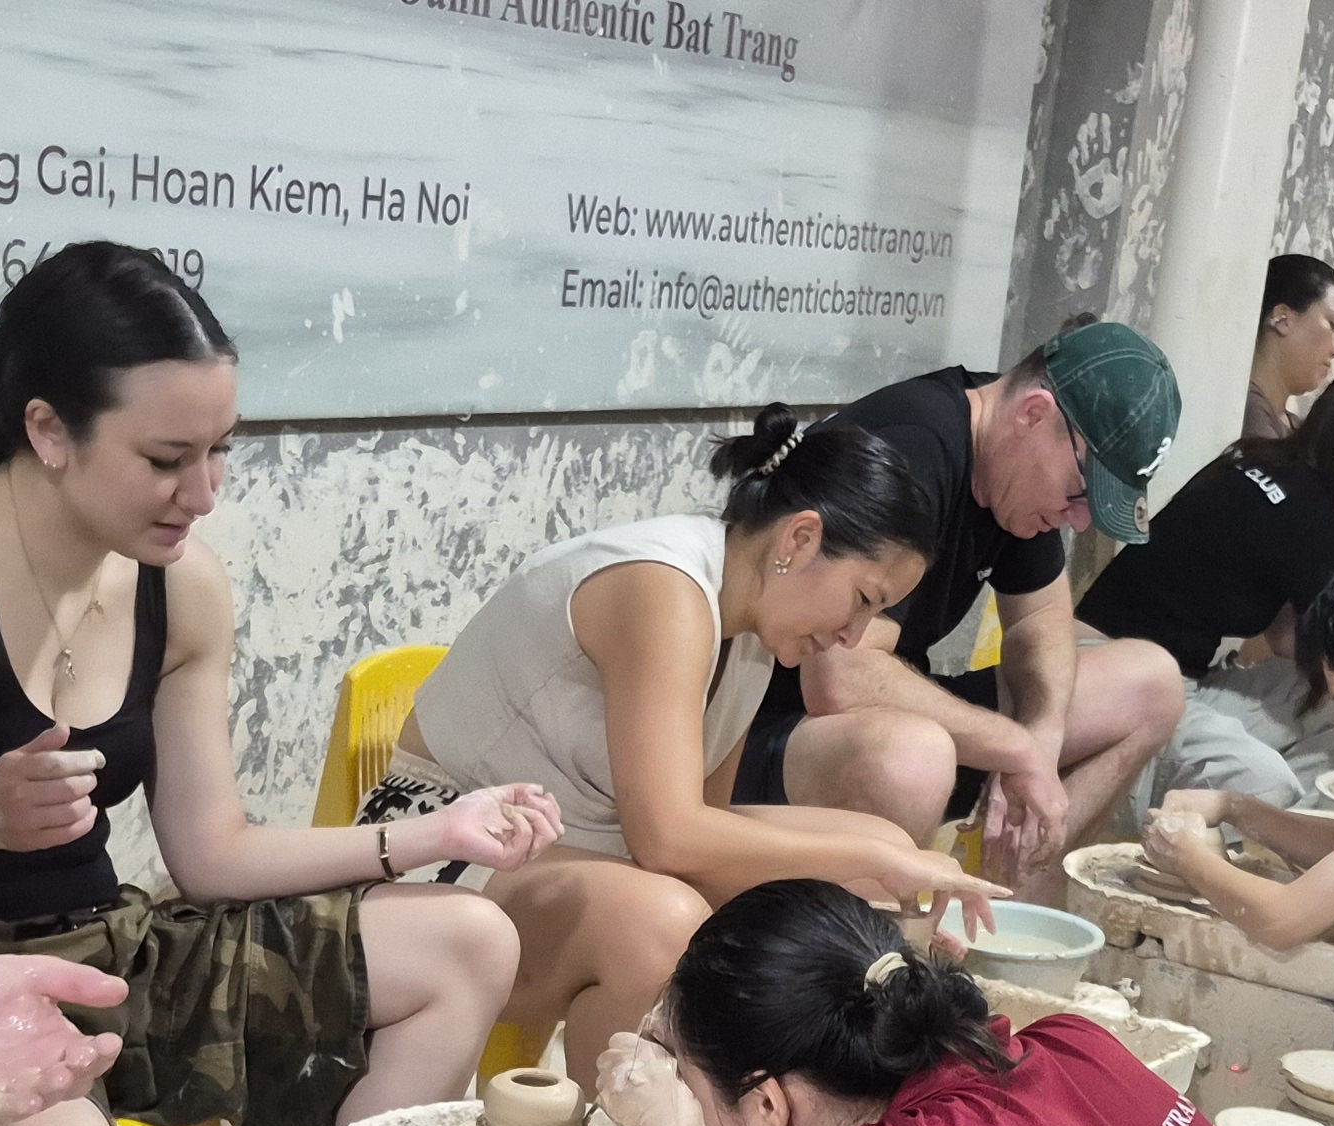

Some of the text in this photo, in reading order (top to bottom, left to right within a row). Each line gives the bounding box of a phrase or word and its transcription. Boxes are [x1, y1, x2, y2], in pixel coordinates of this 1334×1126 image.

[663, 0, 714, 56] Bat
[722, 11, 799, 83] Trang
[37, 145, 115, 209] Gai,
[132, 153, 235, 208] Hoan
[249, 164, 349, 226] Kiem,
[361, 176, 405, 222] Ha
[417, 181, 471, 226] Noi
[567, 193, 953, 264] Web: www.authenticbattrang.vn
[147, 247, 204, 291] 19
[561, 268, 946, 325] Email: info@authenticbattrang.vn
